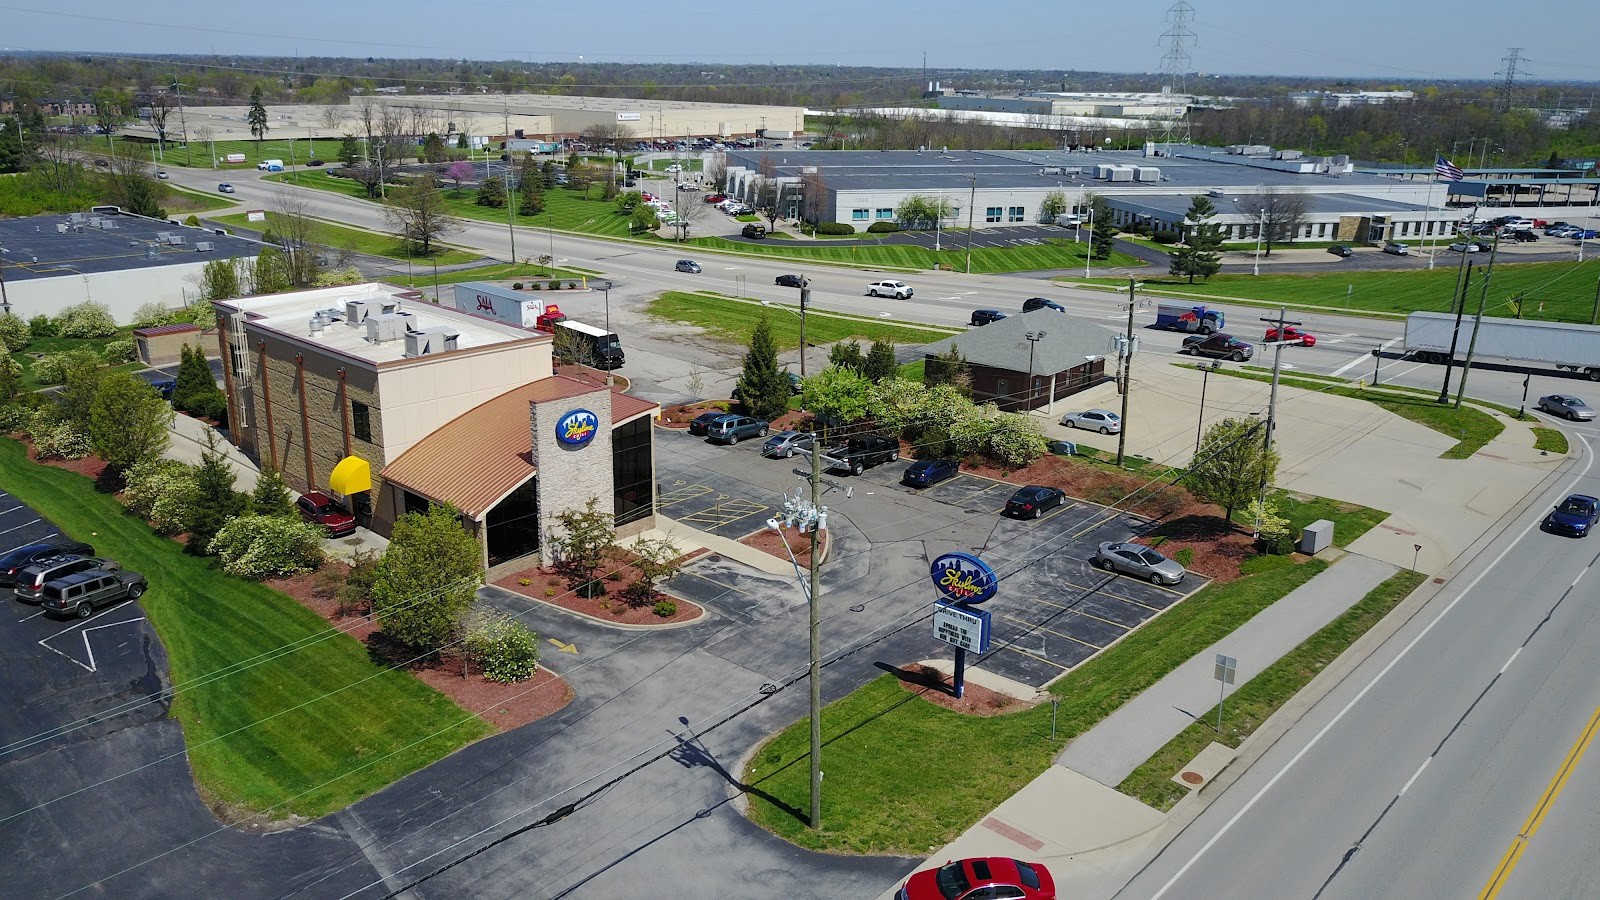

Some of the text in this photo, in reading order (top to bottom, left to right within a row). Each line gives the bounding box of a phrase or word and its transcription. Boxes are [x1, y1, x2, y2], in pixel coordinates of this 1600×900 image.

[565, 421, 594, 440] Skyline
[940, 569, 983, 597] Skyline
[938, 606, 977, 625] DRIVE THRU
[949, 637, 958, 645] GIFT
[961, 635, 971, 643] WITH
